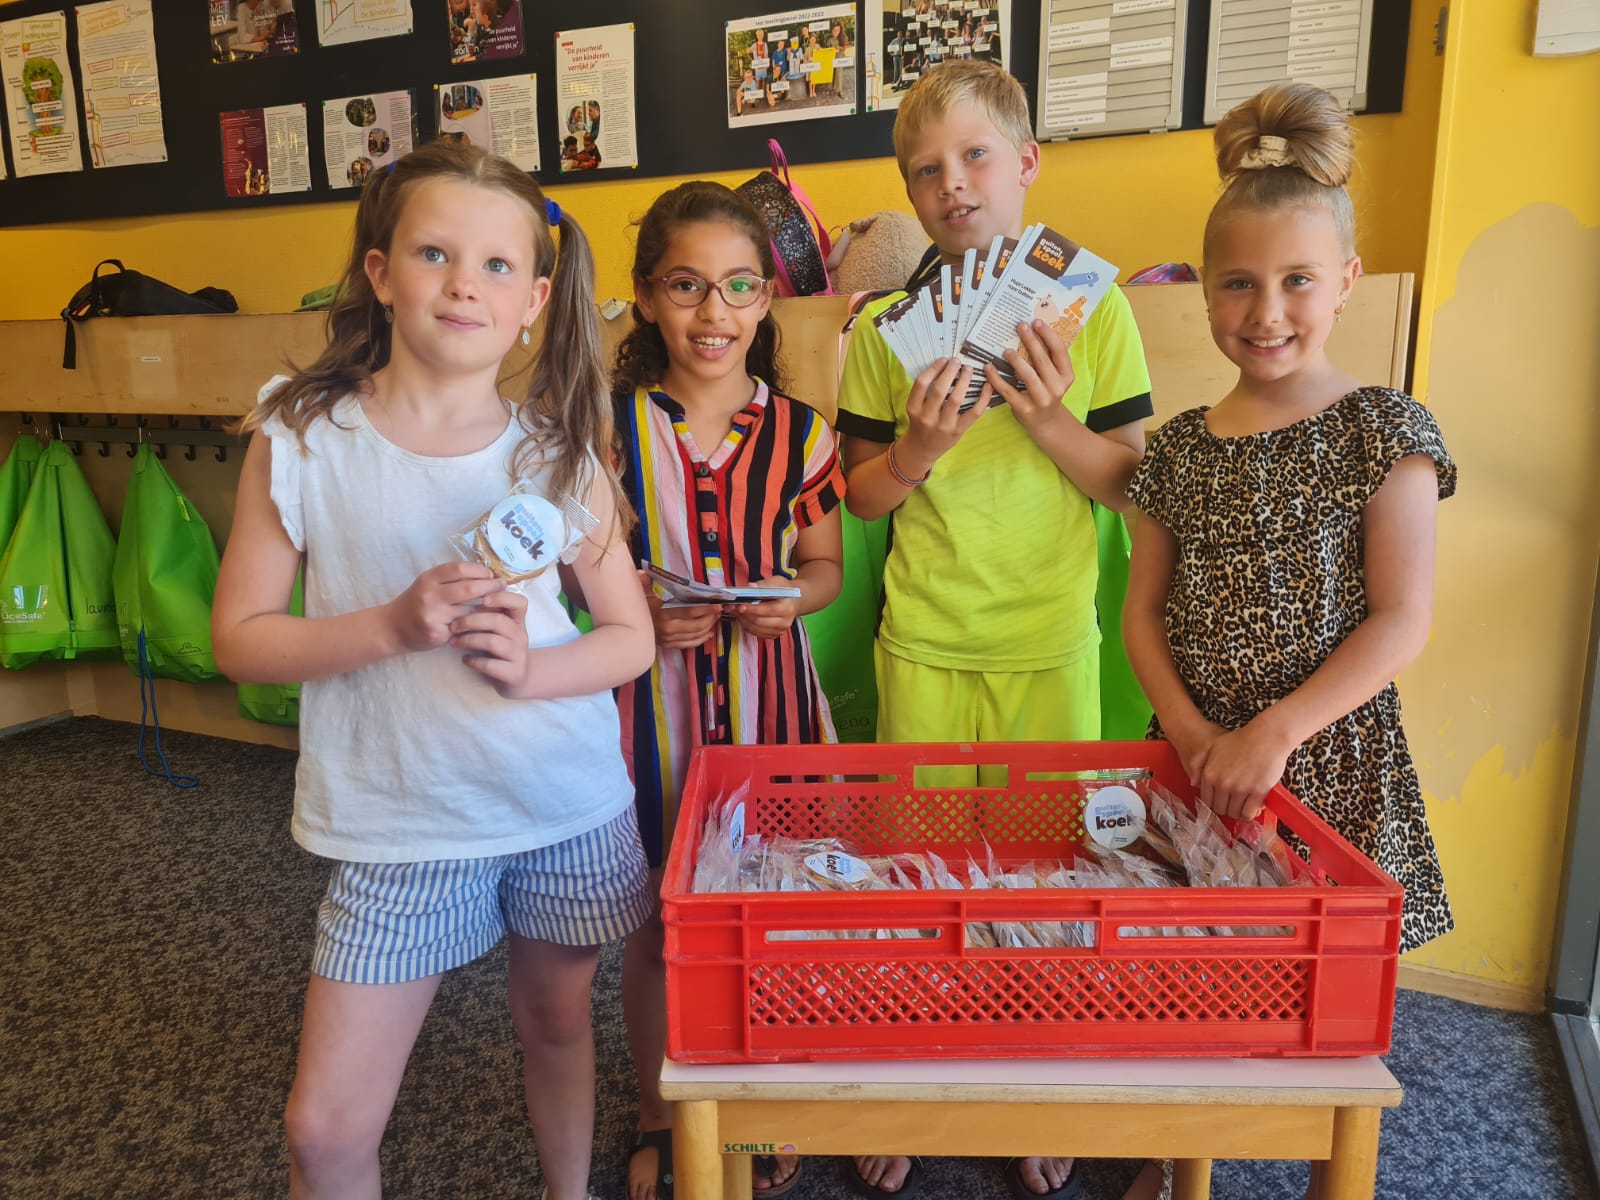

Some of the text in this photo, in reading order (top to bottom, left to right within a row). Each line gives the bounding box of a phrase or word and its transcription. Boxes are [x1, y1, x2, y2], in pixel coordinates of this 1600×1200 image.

[583, 53, 610, 61] kinderen
[1032, 245, 1066, 271] koek
[500, 509, 545, 561] koek
[724, 1143, 776, 1153] SCHILTE
